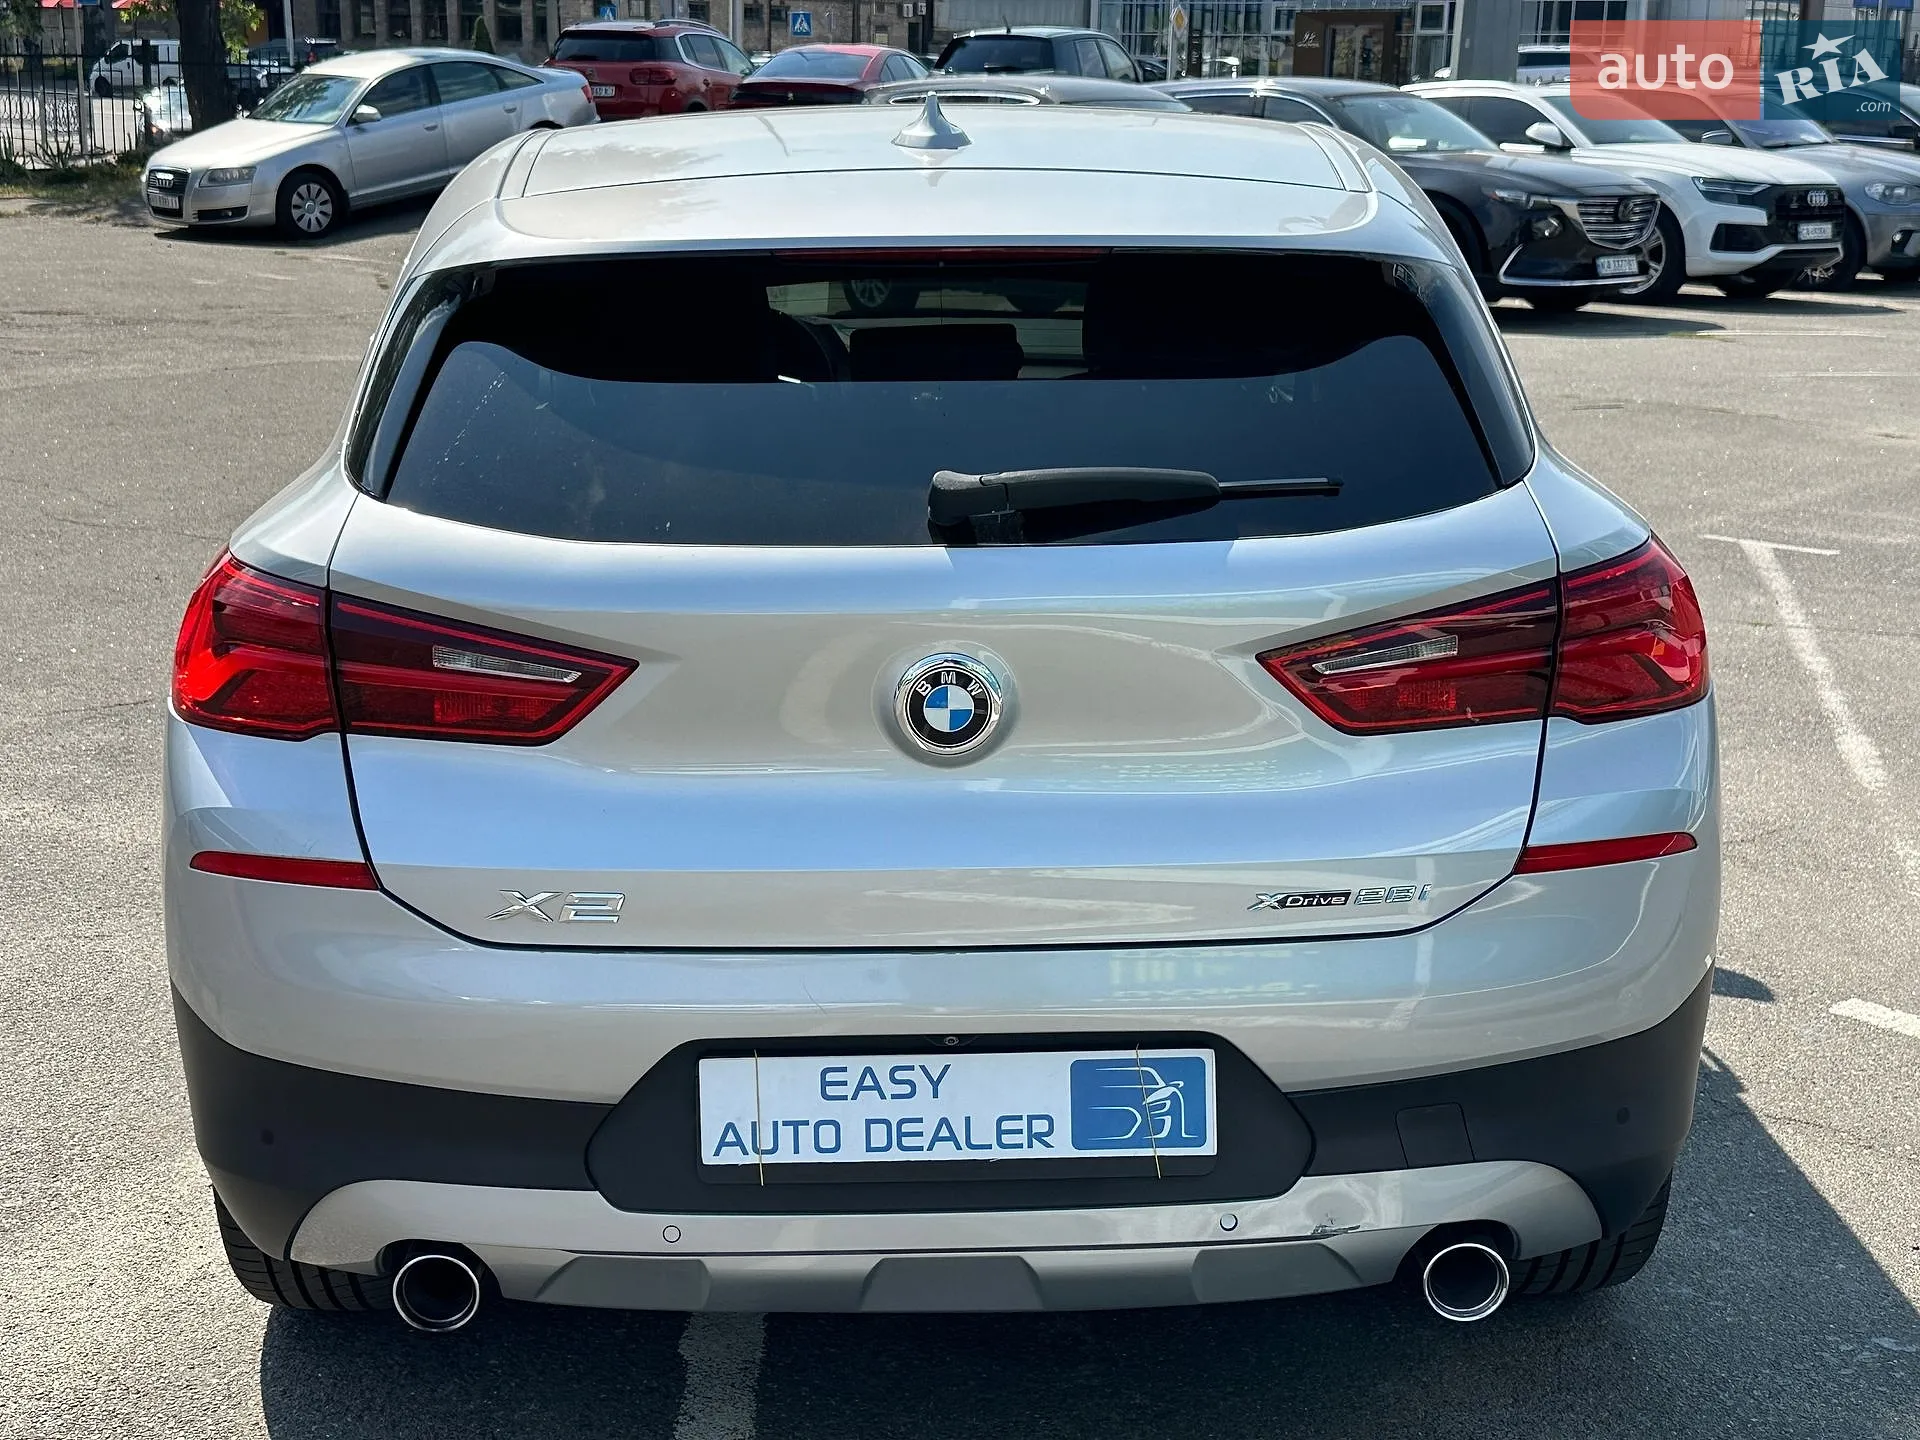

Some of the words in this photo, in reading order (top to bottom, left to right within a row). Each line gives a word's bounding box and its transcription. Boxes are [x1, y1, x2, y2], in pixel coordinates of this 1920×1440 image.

[916, 671, 983, 697] BMW
[485, 889, 626, 923] X2
[1354, 884, 1432, 906] 28i
[819, 1064, 951, 1101] EASY
[713, 1118, 842, 1157] AUTO
[865, 1112, 1056, 1153] DEALER
